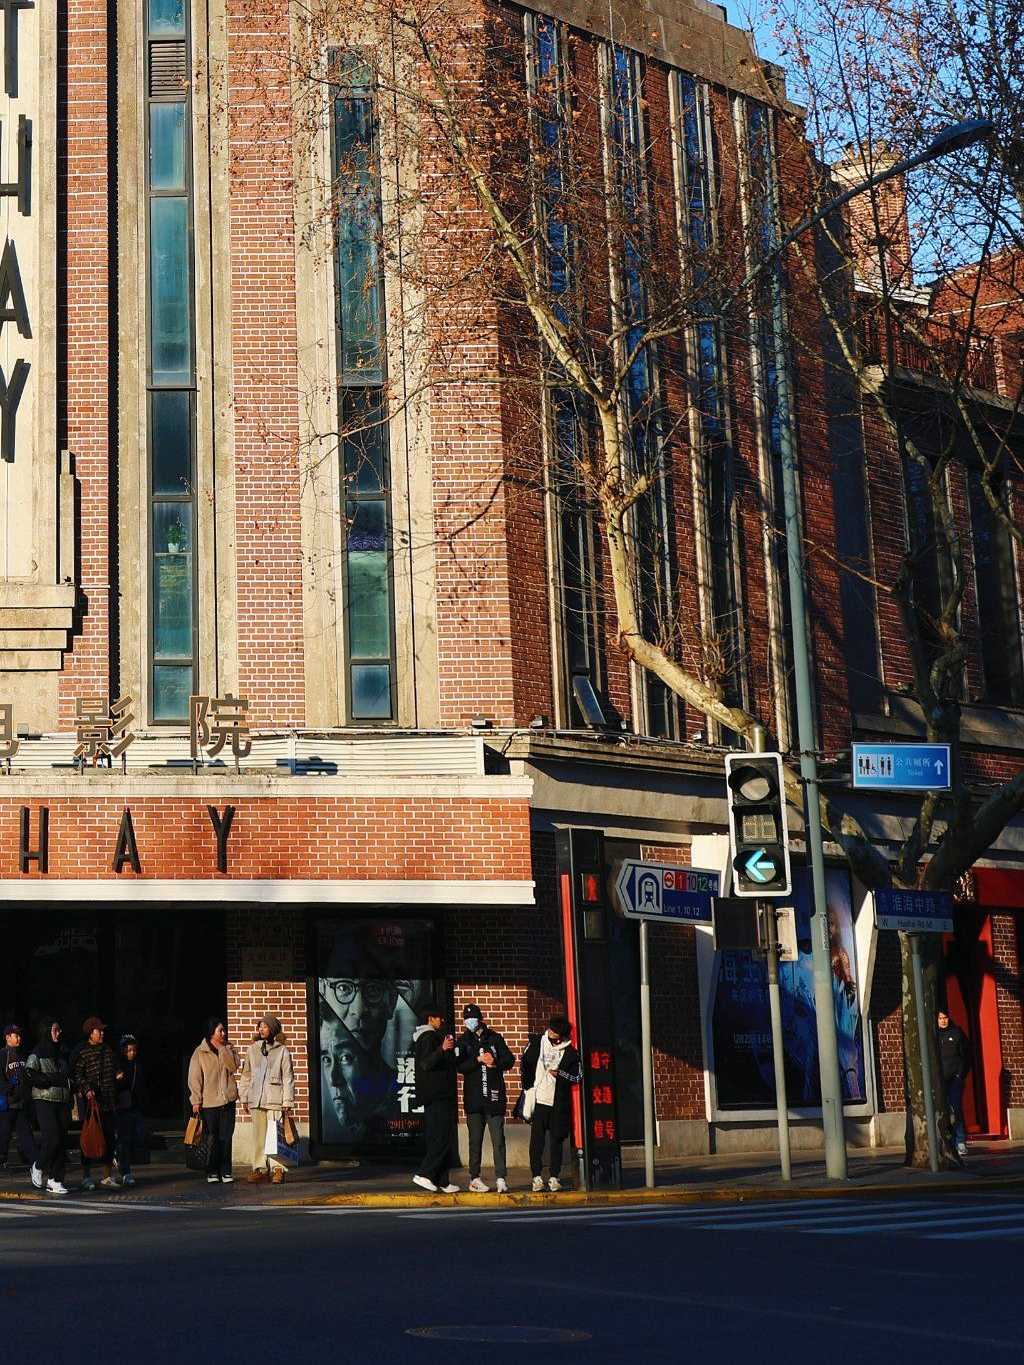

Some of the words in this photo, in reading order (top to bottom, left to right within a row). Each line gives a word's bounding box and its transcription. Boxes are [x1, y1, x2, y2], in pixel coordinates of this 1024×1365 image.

[687, 873, 697, 891] 10
[698, 876, 708, 892] 12
[891, 893, 936, 914] 淮海中路
[594, 1119, 615, 1140] 信号
